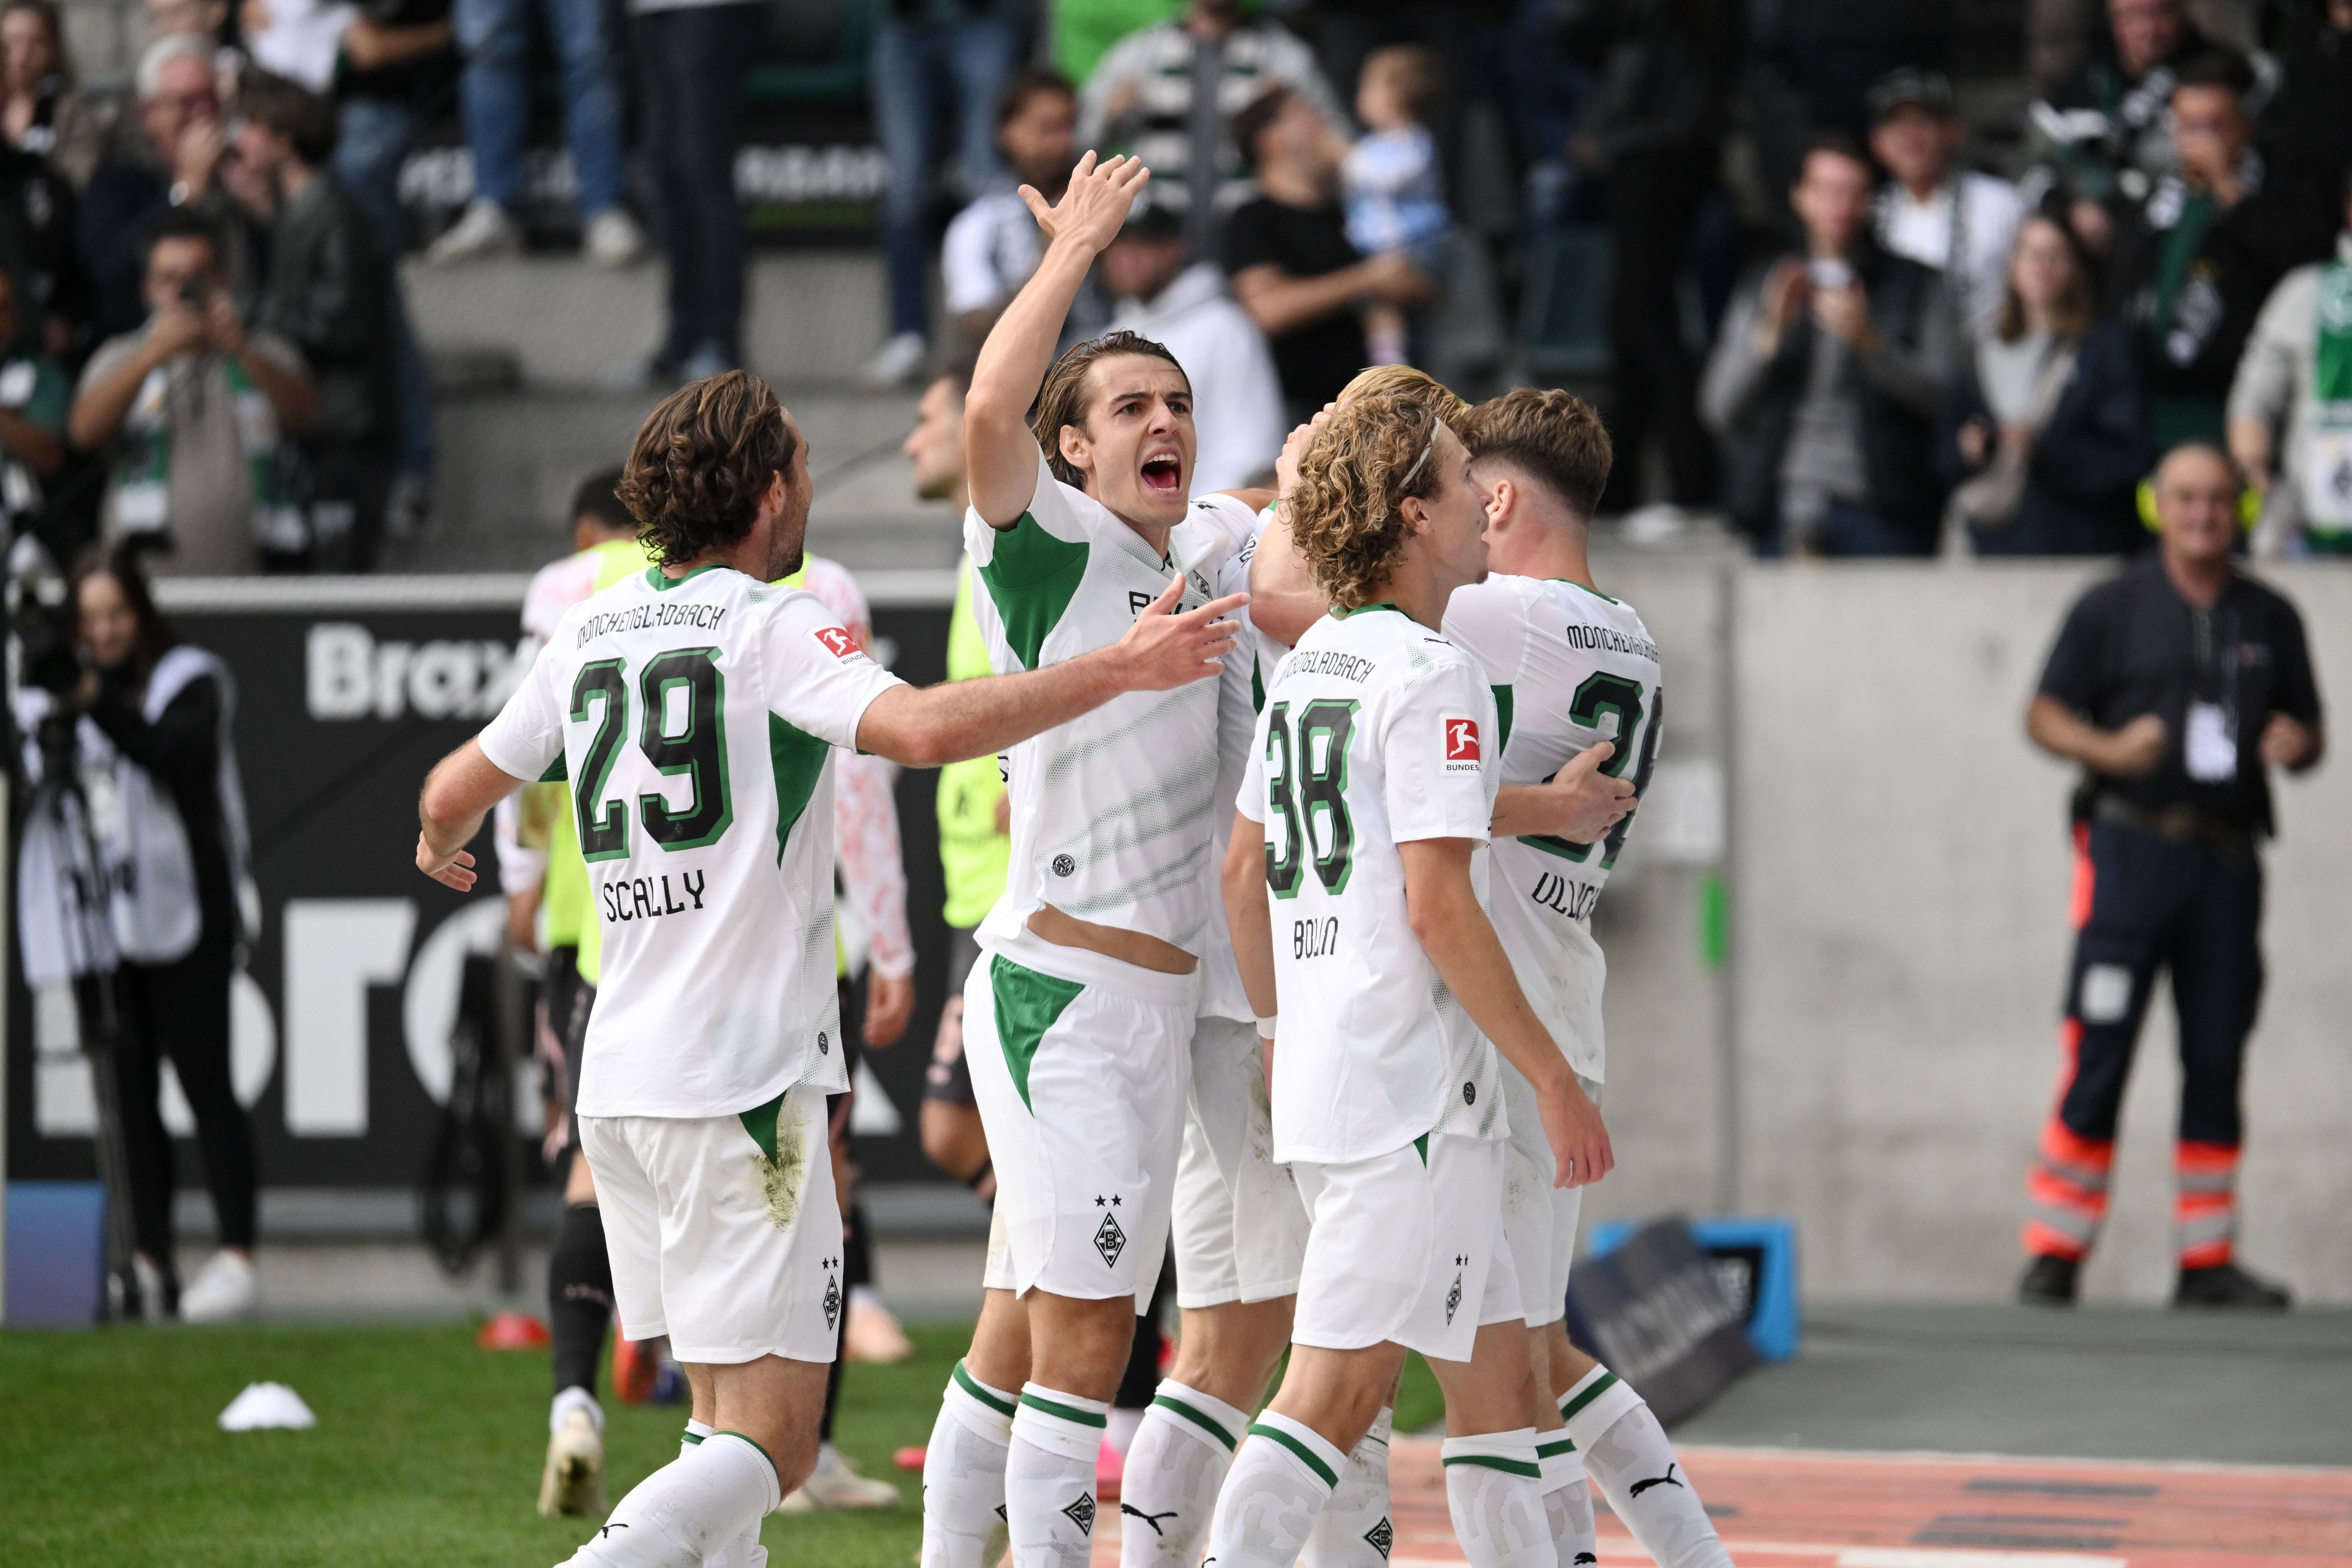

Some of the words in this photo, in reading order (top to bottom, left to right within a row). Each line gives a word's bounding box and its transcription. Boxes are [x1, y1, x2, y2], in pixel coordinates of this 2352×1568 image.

[570, 646, 734, 864] 29
[1265, 698, 1362, 900] 38
[1446, 764, 1482, 773] BUNDES
[603, 869, 705, 922] SCALLY
